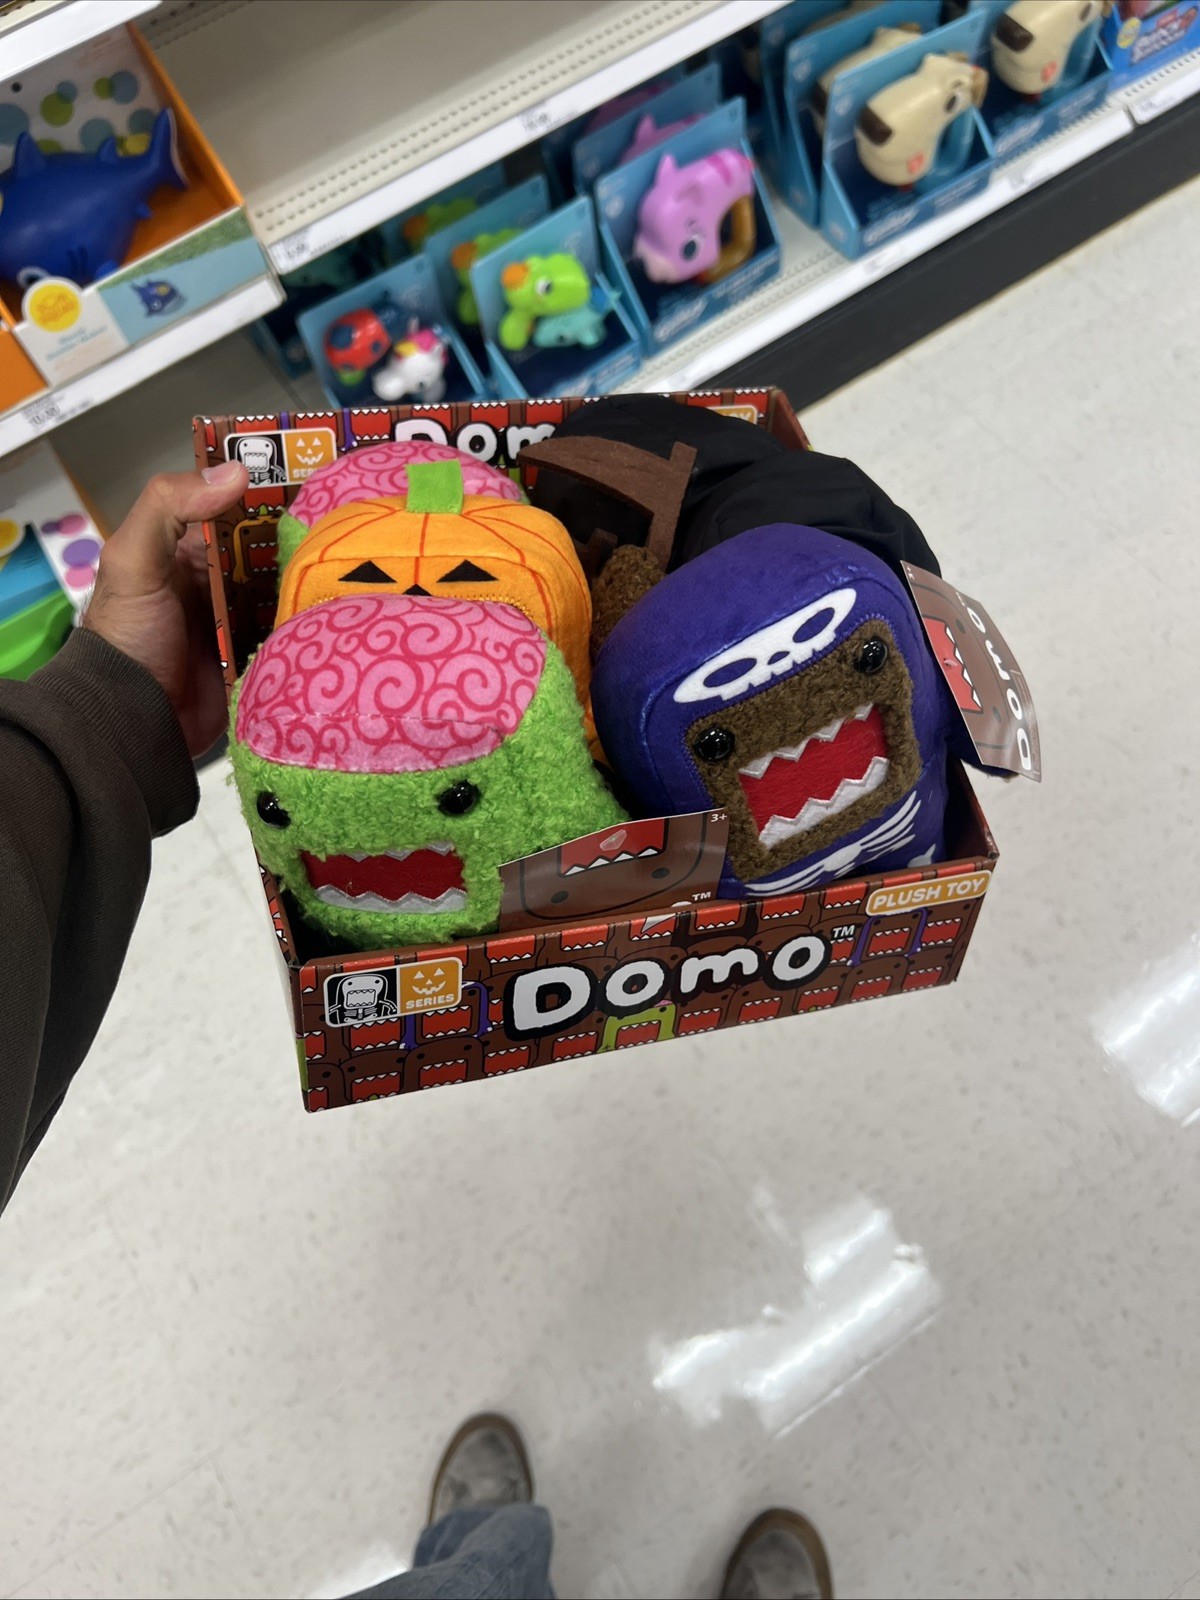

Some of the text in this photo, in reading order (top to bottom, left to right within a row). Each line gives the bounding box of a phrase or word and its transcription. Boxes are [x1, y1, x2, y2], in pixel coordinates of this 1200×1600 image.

[395, 419, 555, 463] Dom
[711, 813, 728, 823] 3+
[692, 891, 712, 901] TM
[873, 877, 986, 910] PLUSH TOY
[513, 924, 856, 1032] Domo TM
[405, 993, 455, 1010] SERIES
